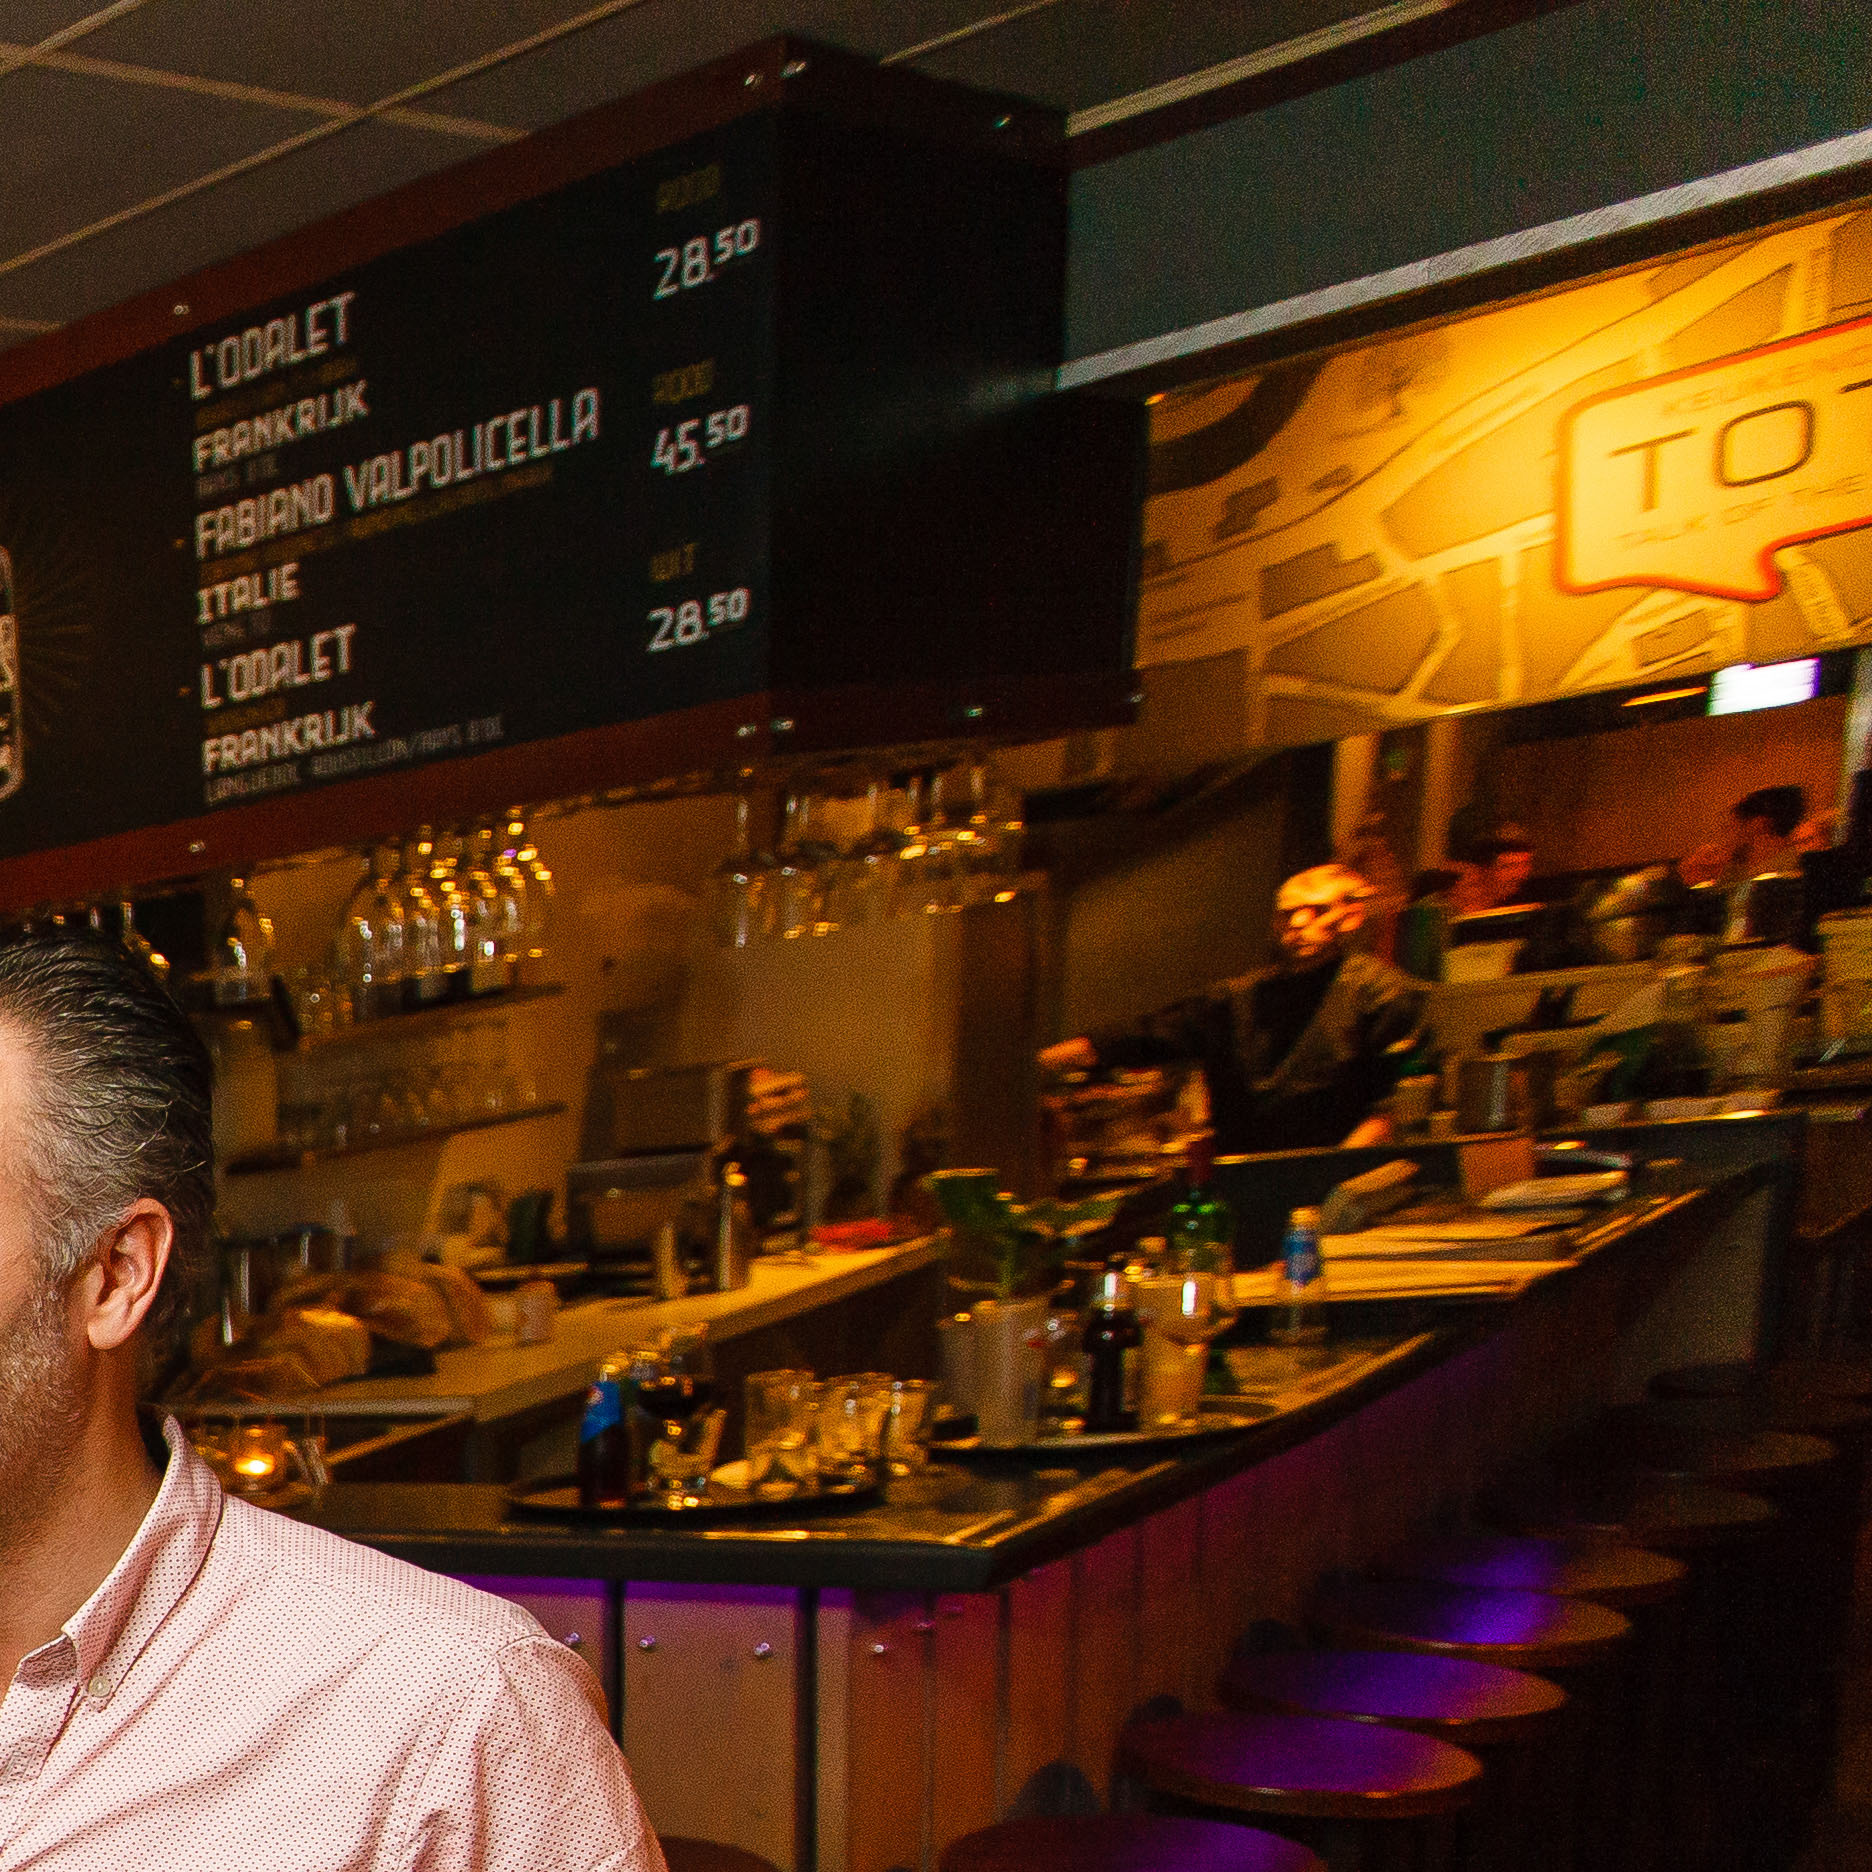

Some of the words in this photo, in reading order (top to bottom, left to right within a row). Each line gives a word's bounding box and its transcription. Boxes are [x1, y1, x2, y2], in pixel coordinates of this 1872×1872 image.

[651, 217, 761, 301] 28.50
[189, 292, 355, 400] L'ODALET
[192, 379, 370, 474] FRANKRIJK
[650, 403, 752, 475] 45.50
[1607, 378, 1872, 511] TO
[194, 471, 337, 560] FABIANO
[343, 386, 602, 513] VALPOLICELLA
[646, 587, 752, 654] 28.50
[200, 622, 356, 710] L'ODALET
[202, 700, 377, 777] FRANKRIJK
